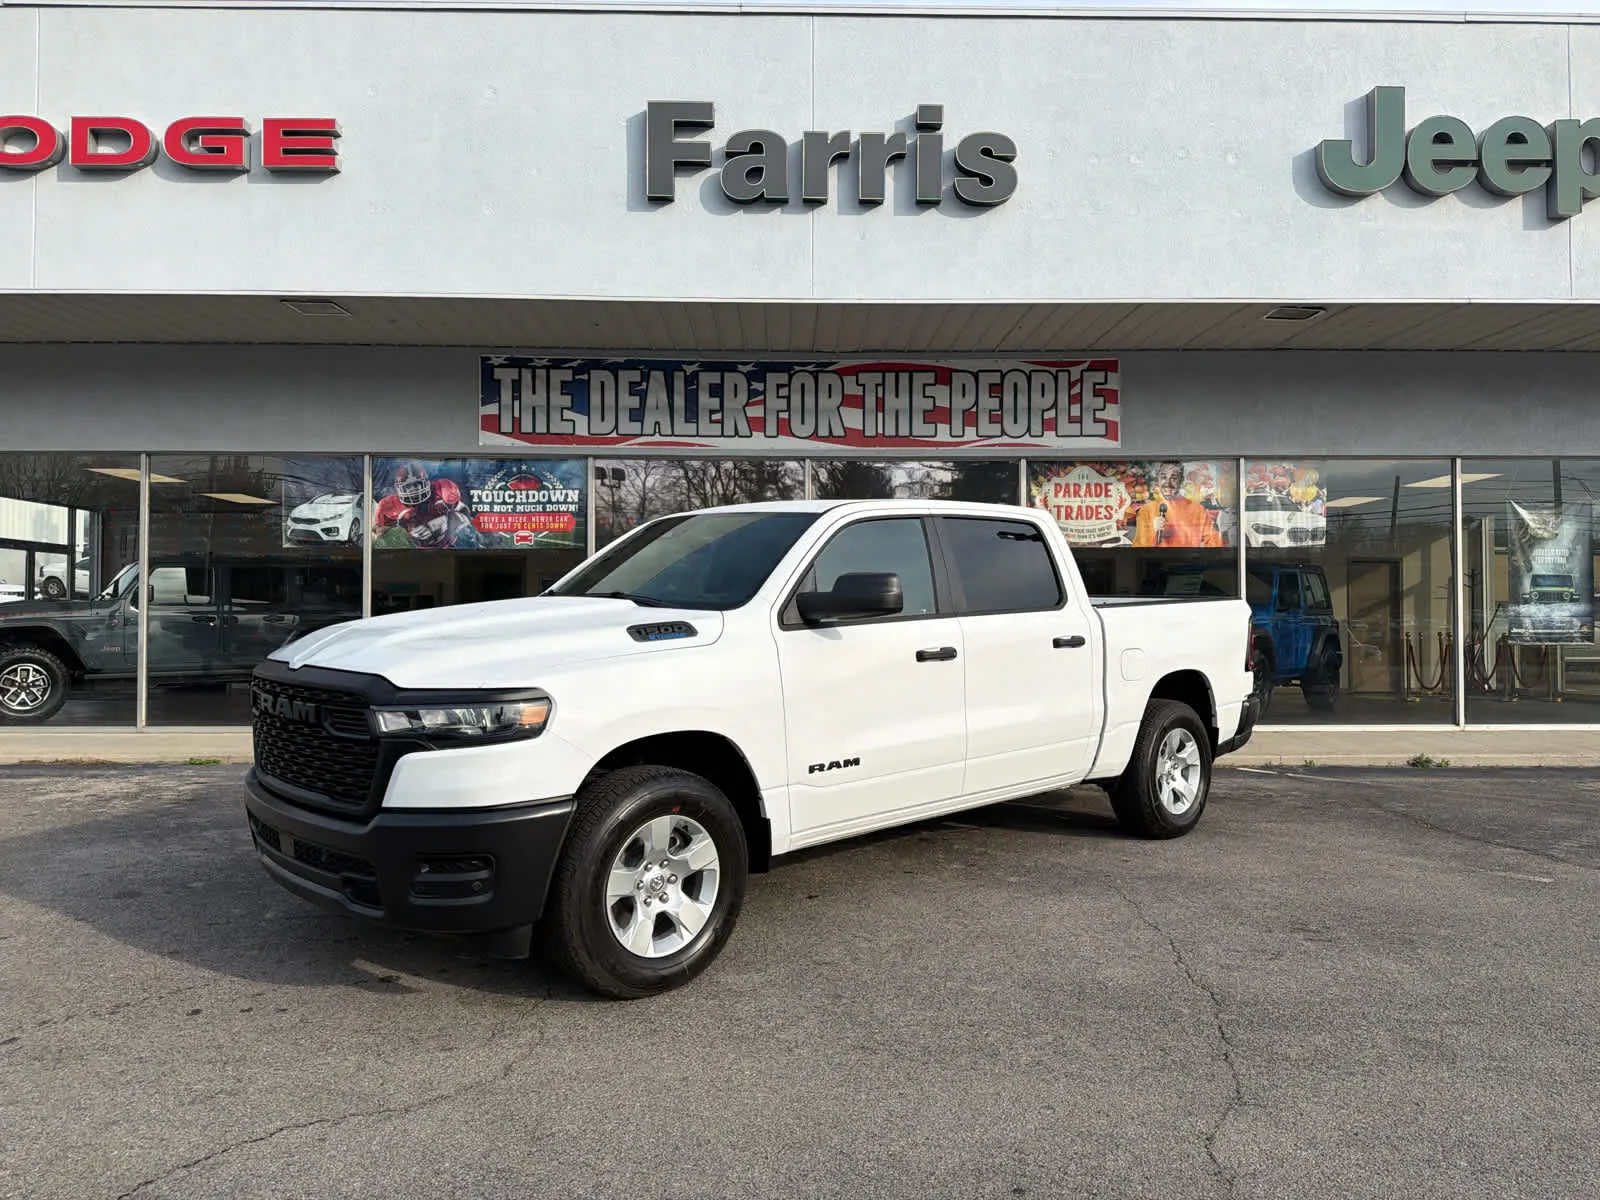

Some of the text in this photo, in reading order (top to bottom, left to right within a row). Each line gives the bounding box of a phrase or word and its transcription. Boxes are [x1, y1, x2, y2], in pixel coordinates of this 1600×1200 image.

[646, 101, 1019, 206] Farris
[494, 367, 1108, 439] THE DEALER FOR THE PEOPLE
[470, 489, 580, 503] TOUCHDOWN
[1053, 482, 1113, 498] PARADE
[471, 504, 579, 512] FOR NOT MUCH DOWN!
[1053, 504, 1114, 521] TRADES
[259, 691, 319, 722] RAM
[808, 757, 861, 774] RAM
